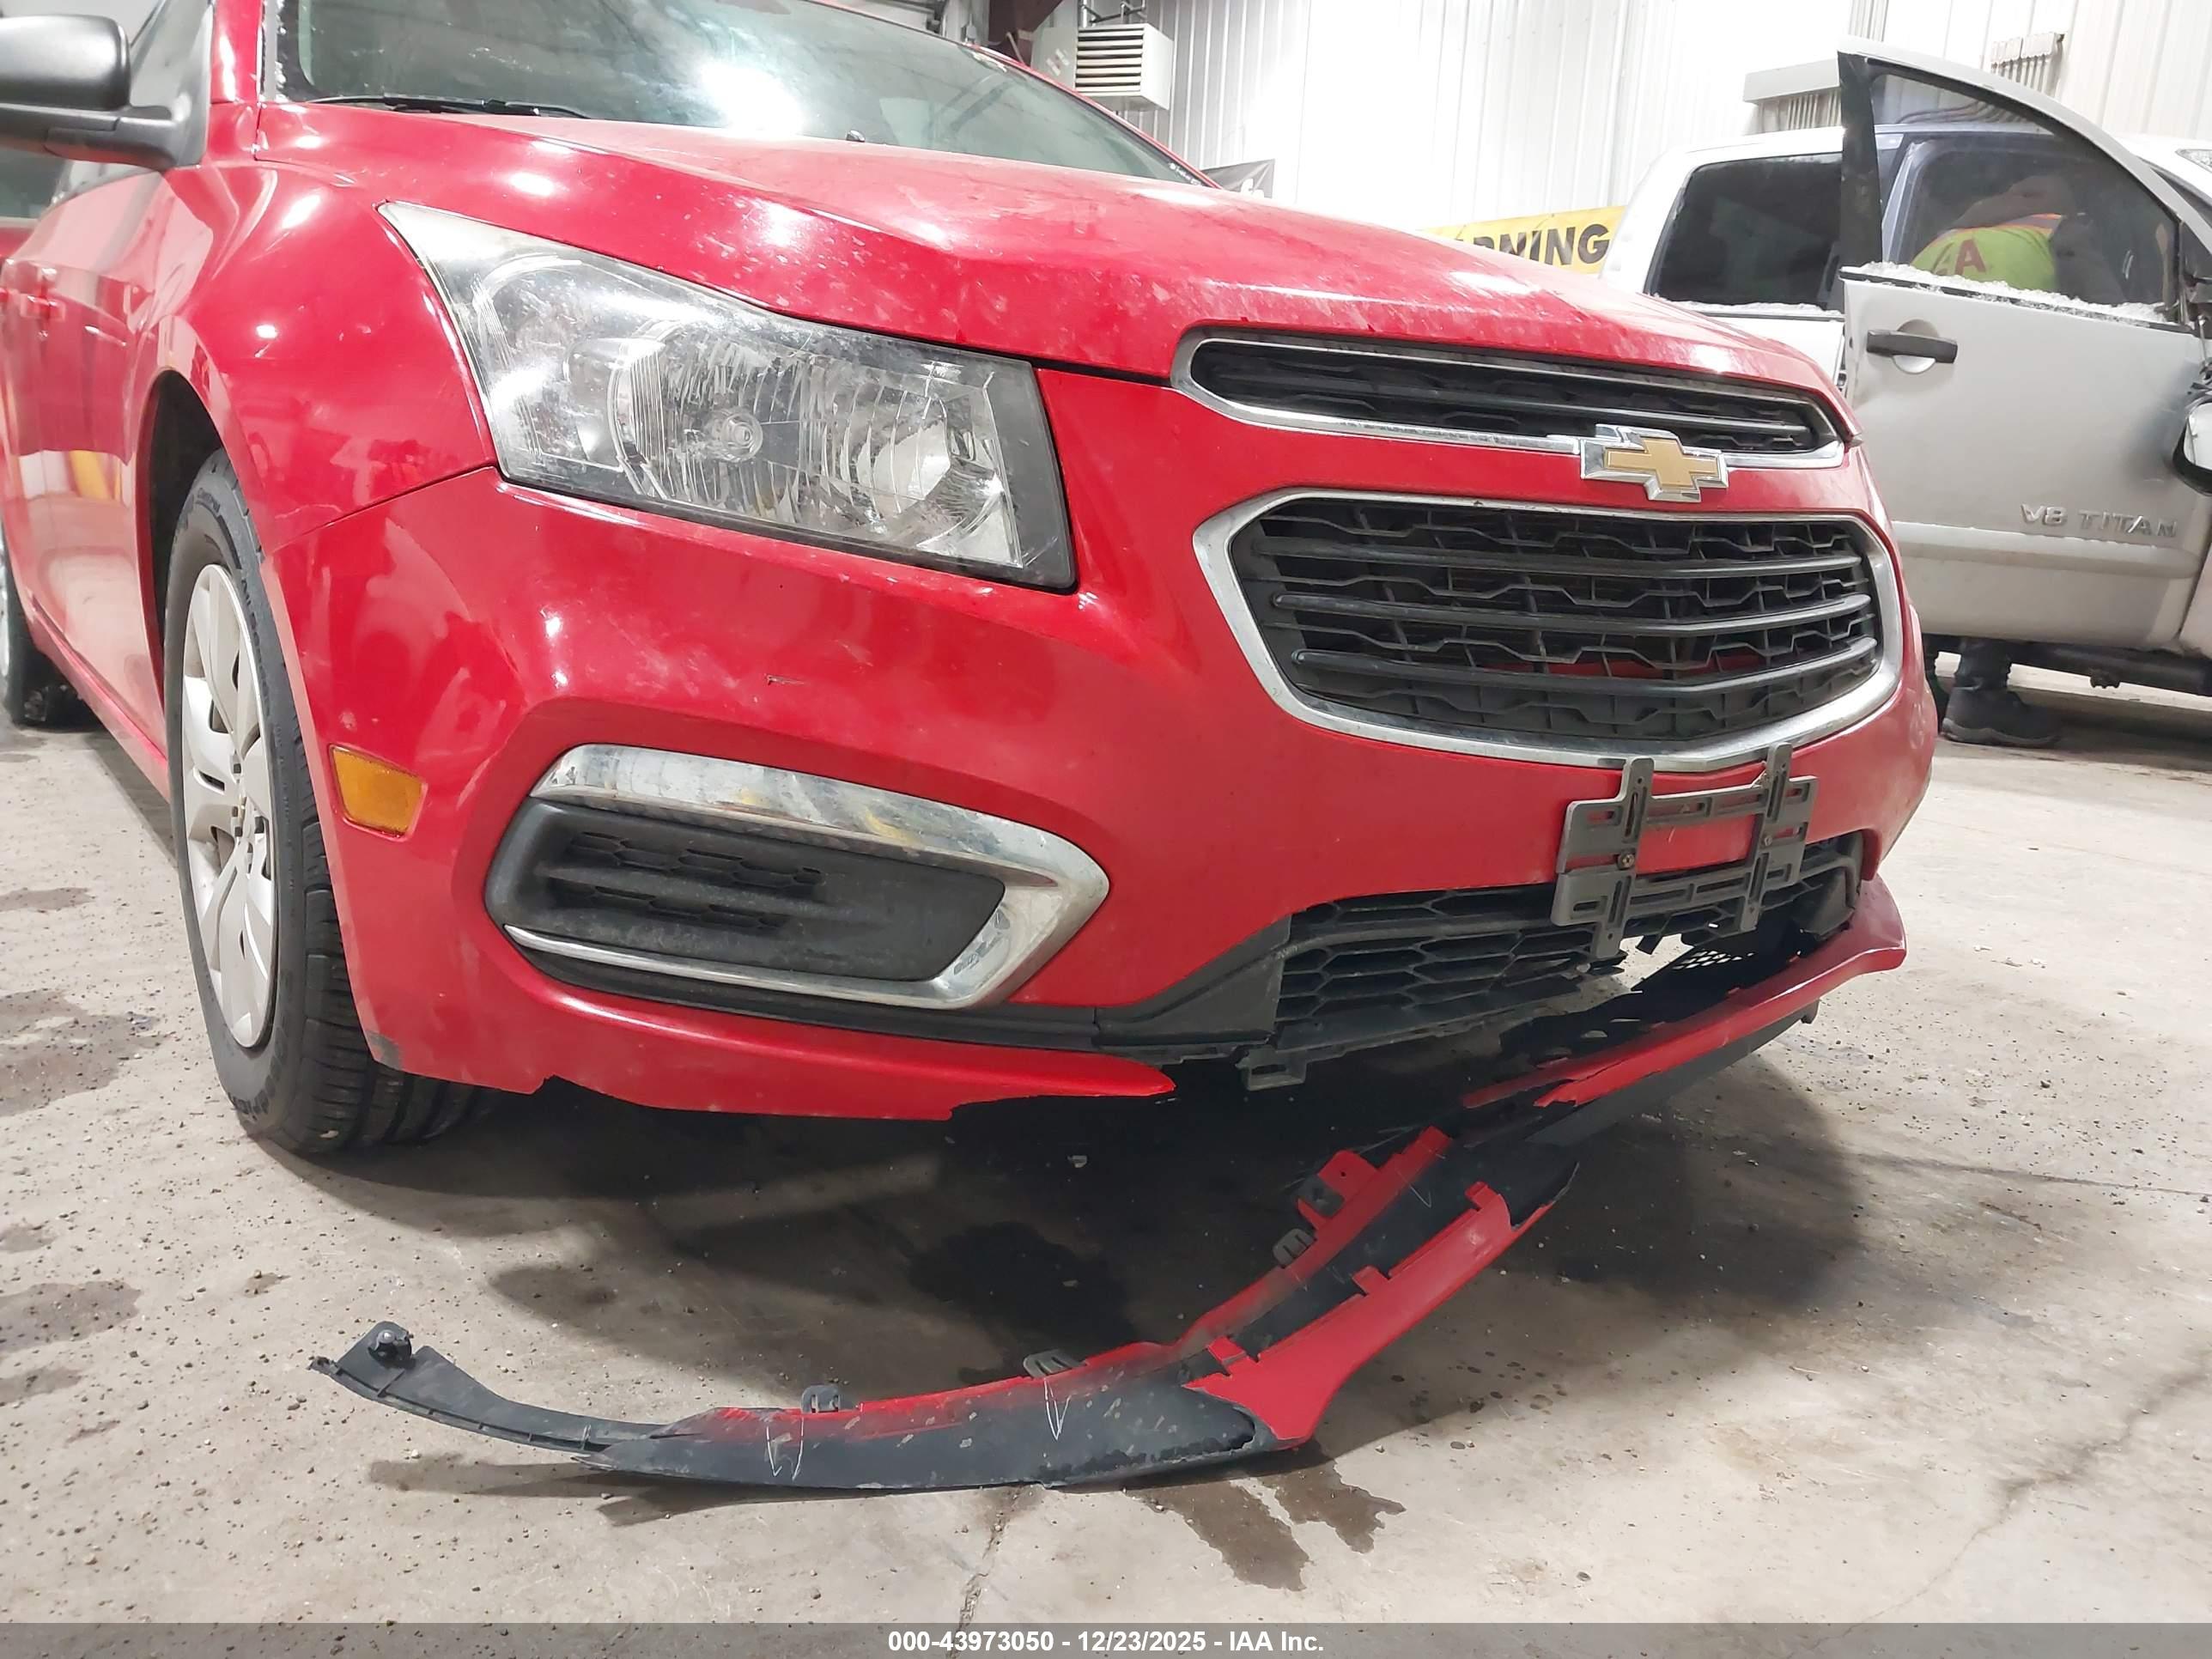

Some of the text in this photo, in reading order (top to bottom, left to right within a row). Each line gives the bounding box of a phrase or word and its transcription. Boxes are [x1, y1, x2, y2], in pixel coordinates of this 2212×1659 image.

[1455, 223, 1611, 266] NING
[2021, 503, 2179, 538] V8 TITAN
